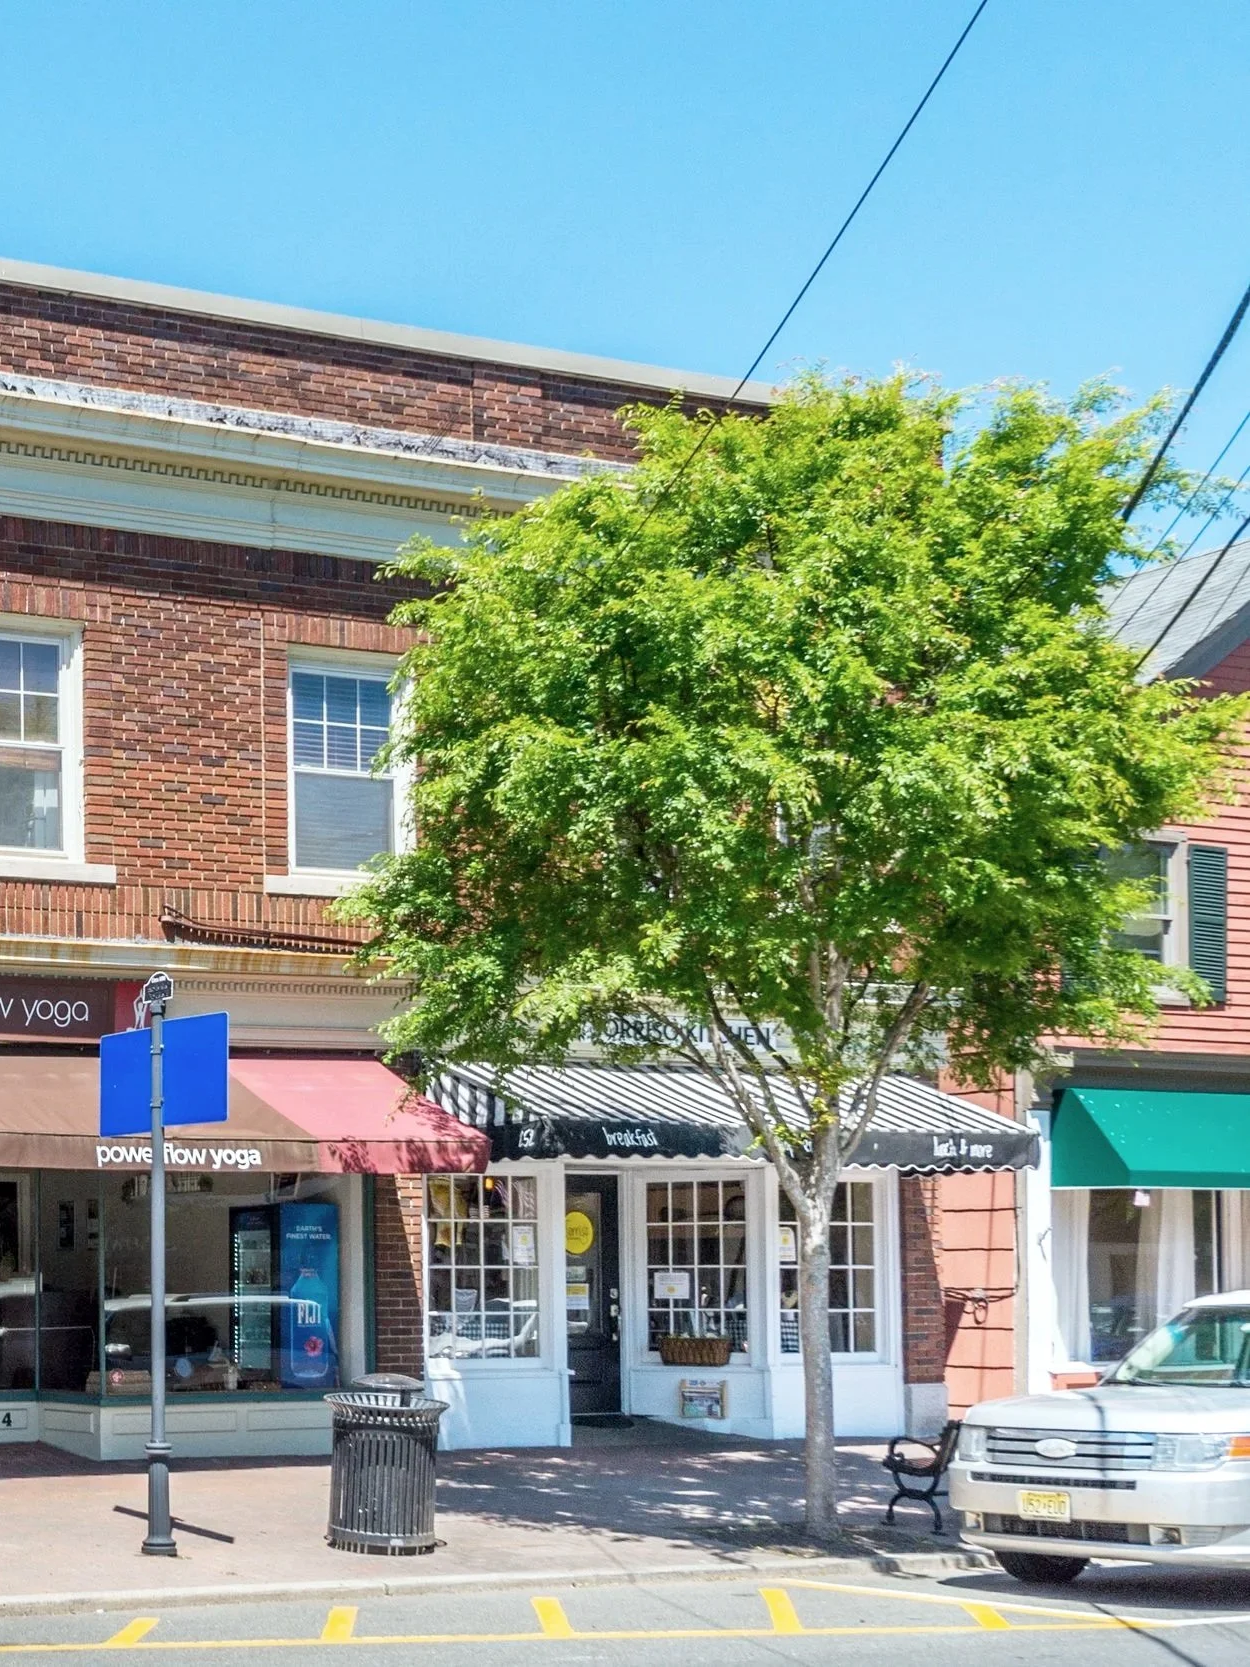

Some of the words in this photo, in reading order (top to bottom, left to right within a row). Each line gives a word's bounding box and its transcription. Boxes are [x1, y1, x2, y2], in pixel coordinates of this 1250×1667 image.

[21, 999, 89, 1027] yoga
[601, 1126, 659, 1148] breakfast
[96, 1142, 206, 1167] poweflow
[210, 1148, 262, 1169] yoga
[297, 1302, 321, 1324] FIJI
